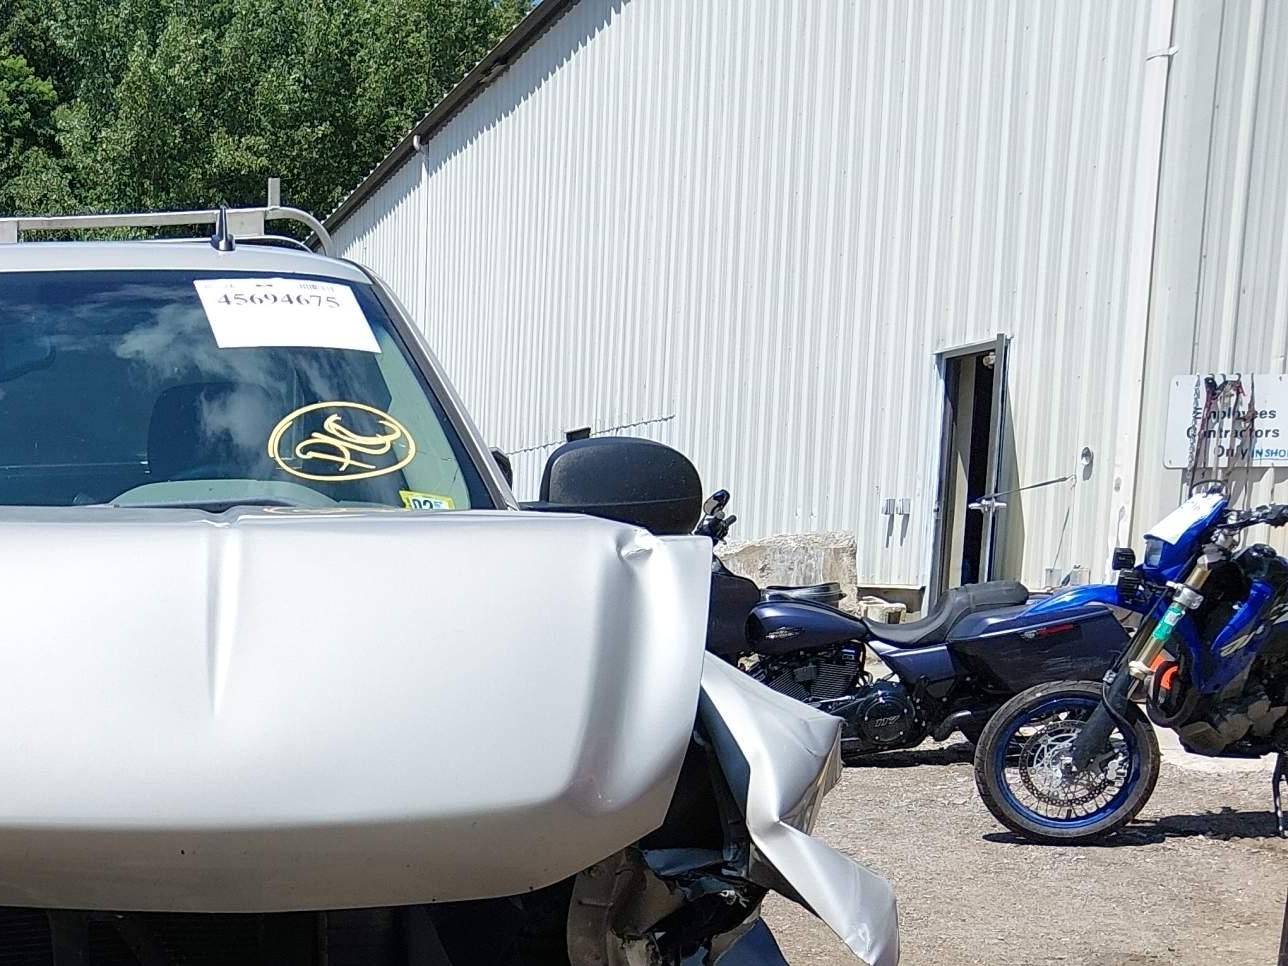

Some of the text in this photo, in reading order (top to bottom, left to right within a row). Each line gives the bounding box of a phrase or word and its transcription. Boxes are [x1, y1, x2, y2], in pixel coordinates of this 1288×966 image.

[217, 293, 340, 309] 45694675
[1186, 426, 1280, 438] Cntracors
[1213, 445, 1249, 460] Ony
[1265, 448, 1288, 458] SHO
